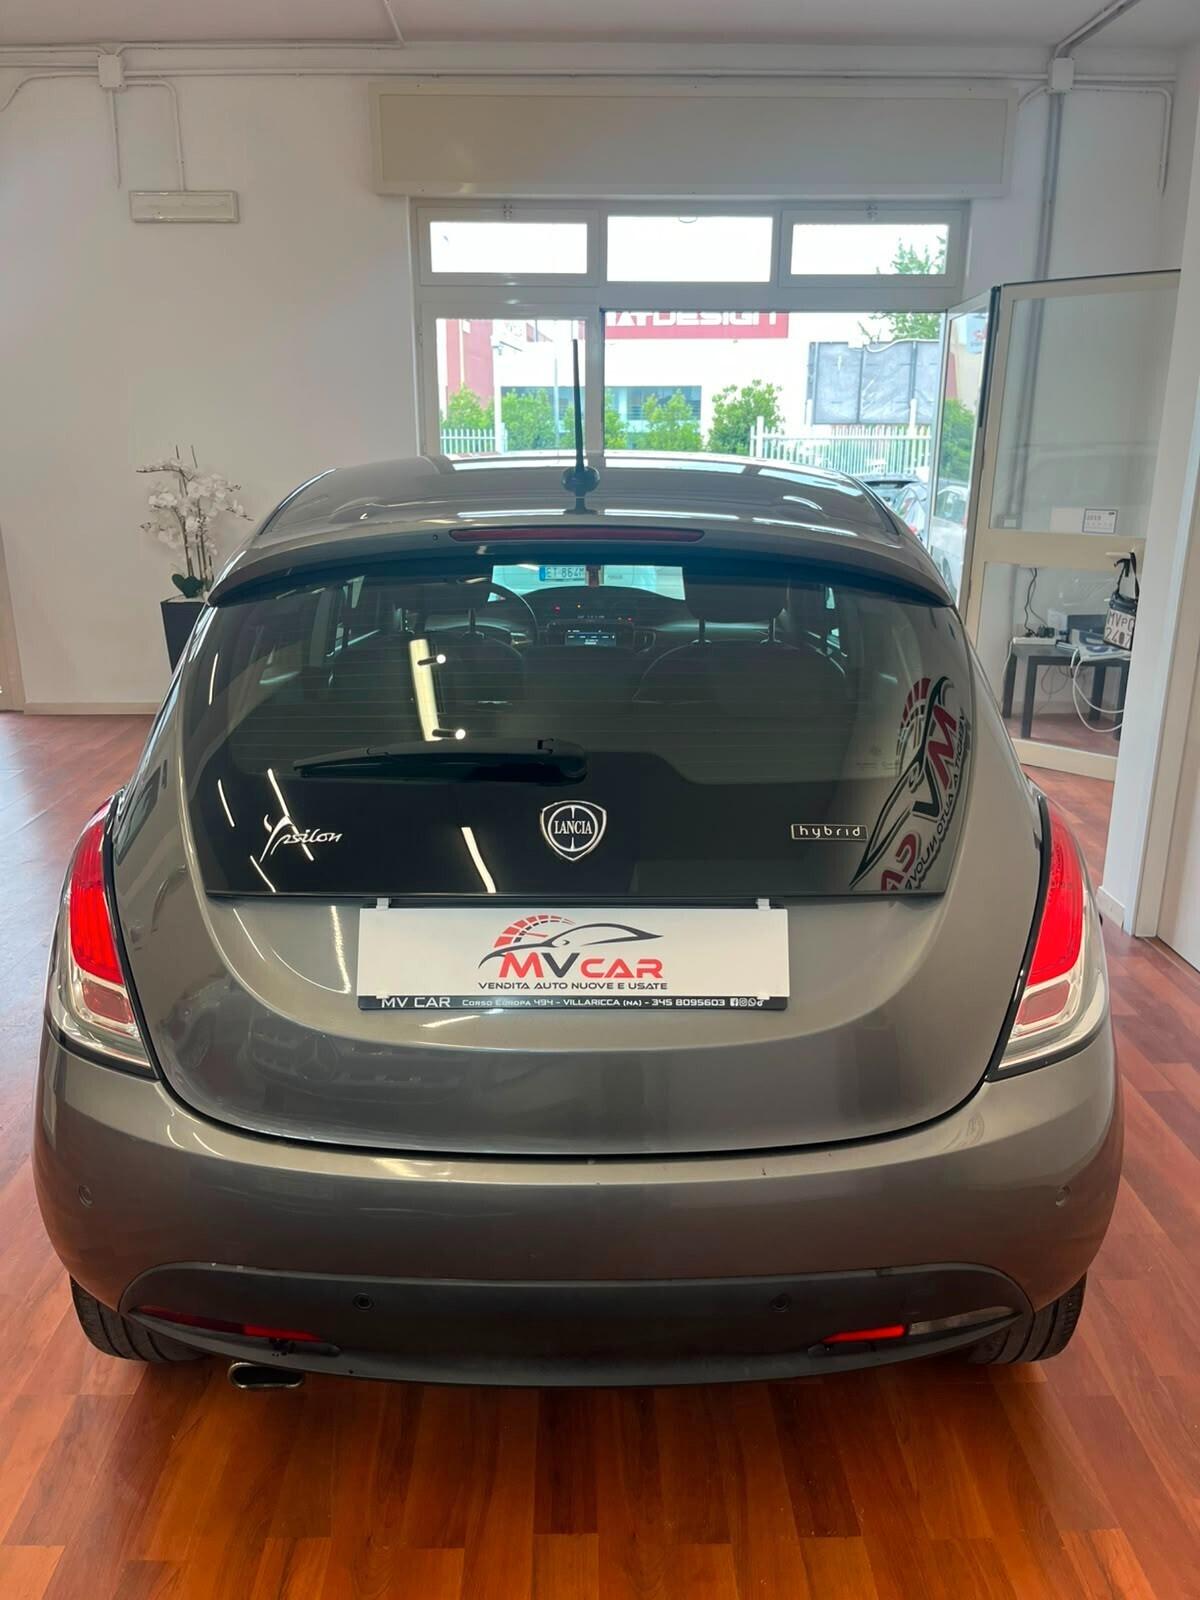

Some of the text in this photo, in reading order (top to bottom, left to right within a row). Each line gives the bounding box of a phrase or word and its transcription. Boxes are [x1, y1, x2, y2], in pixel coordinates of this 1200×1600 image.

[554, 820, 592, 835] LANCIA
[799, 825, 861, 839] hybrid
[260, 814, 343, 863] Ypsilon
[478, 982, 668, 990] VENDITA AUTO NUOVE E USATE
[381, 997, 409, 1008] MV
[414, 997, 450, 1008] CAR
[563, 998, 620, 1006] VILLARICCA
[651, 998, 673, 1006] 345
[675, 998, 726, 1006] 8095603
